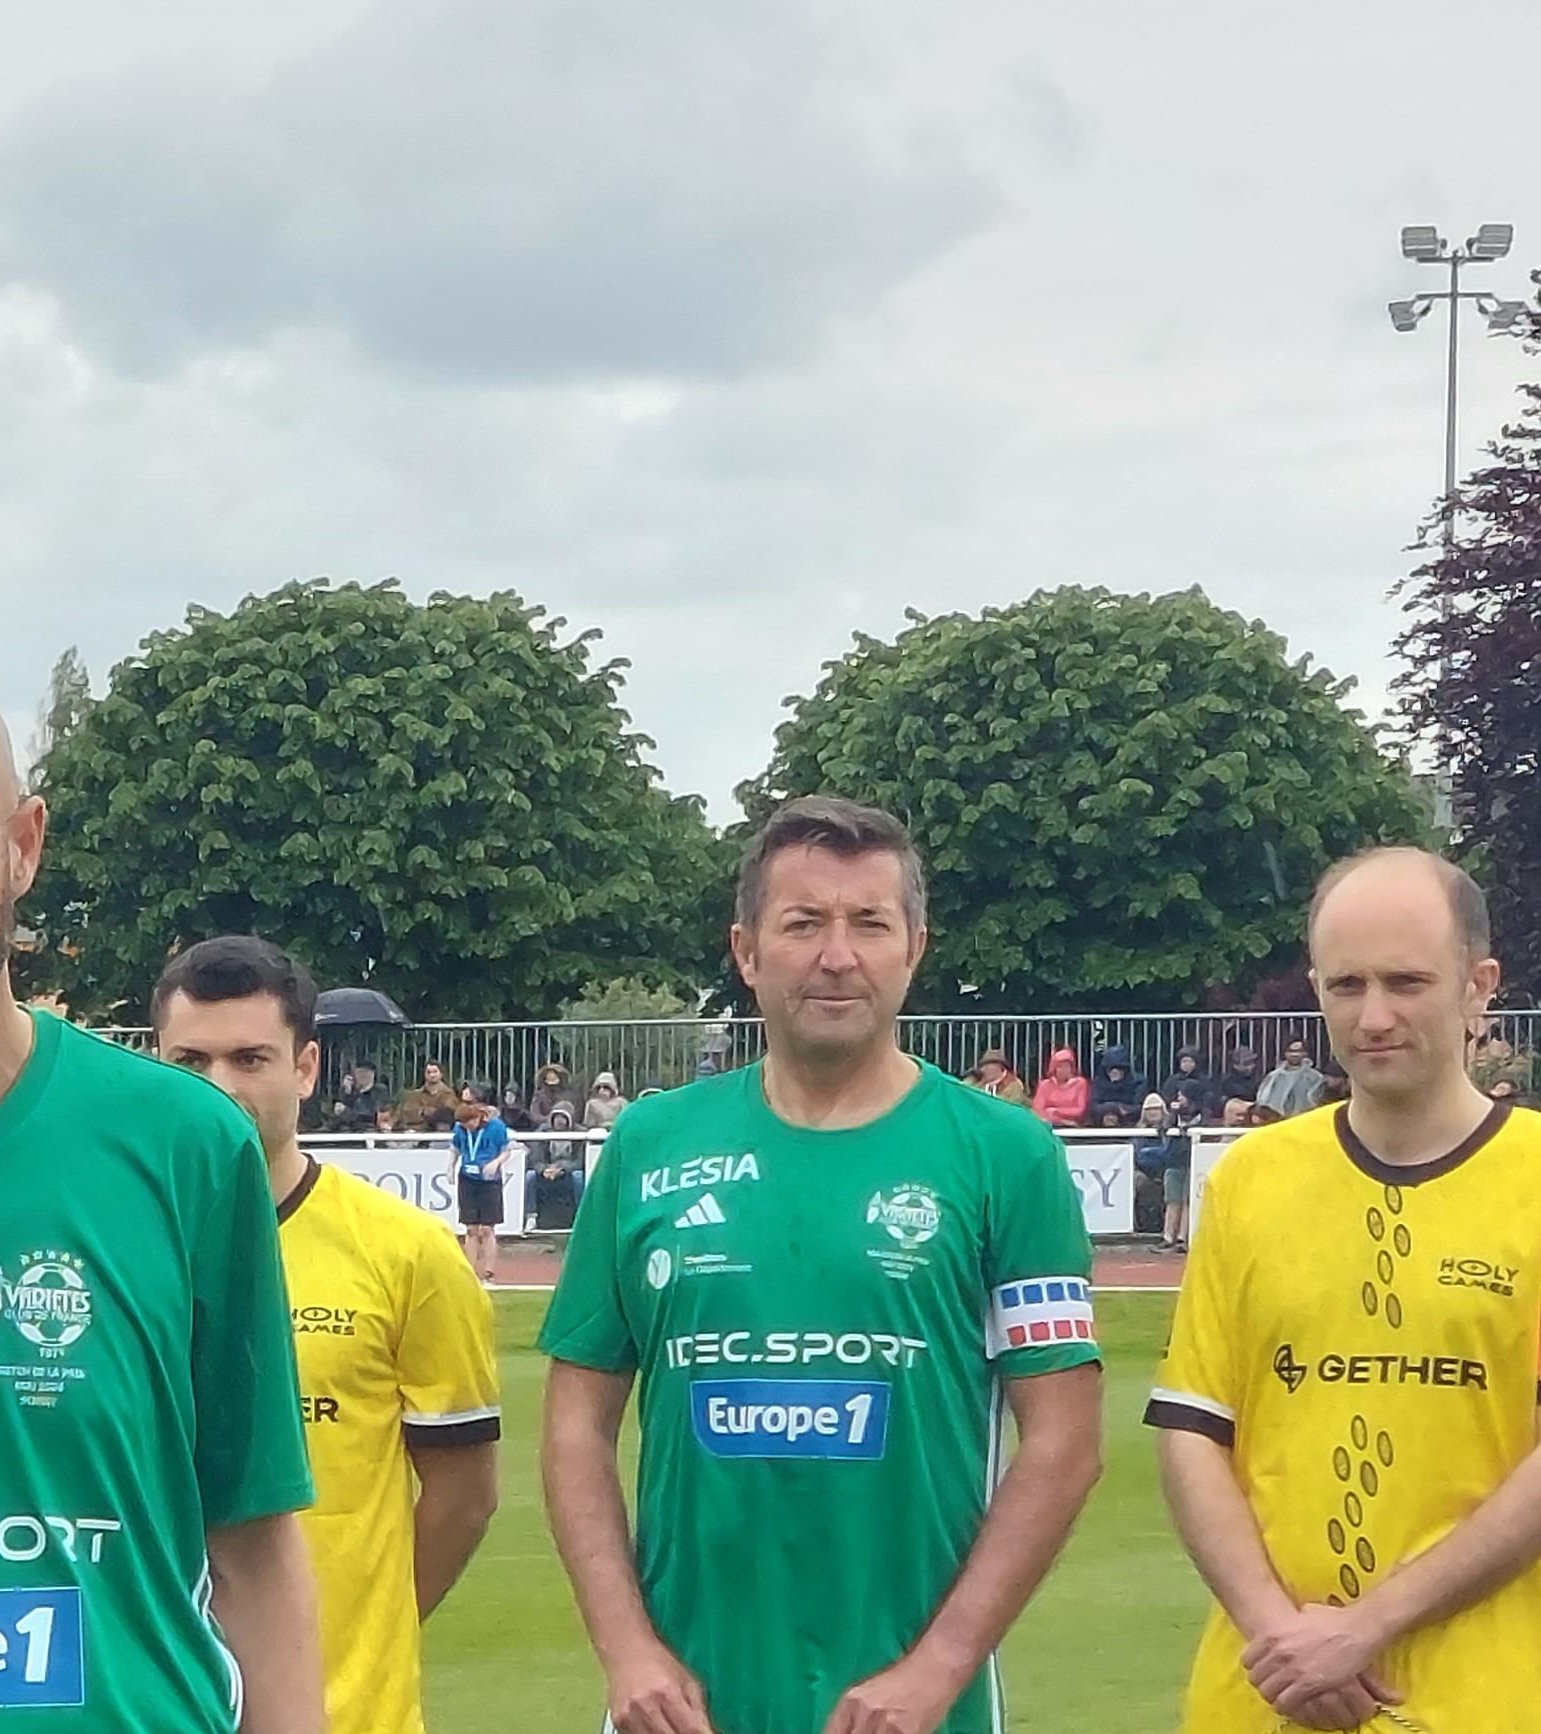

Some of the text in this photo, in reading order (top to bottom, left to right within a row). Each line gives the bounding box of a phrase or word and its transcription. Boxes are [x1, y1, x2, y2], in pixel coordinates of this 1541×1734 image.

[1440, 1258, 1519, 1282] HOLY
[293, 1324, 355, 1336] AMES
[665, 1331, 929, 1369] IDEC.SPORT
[1318, 1354, 1488, 1390] GETHER
